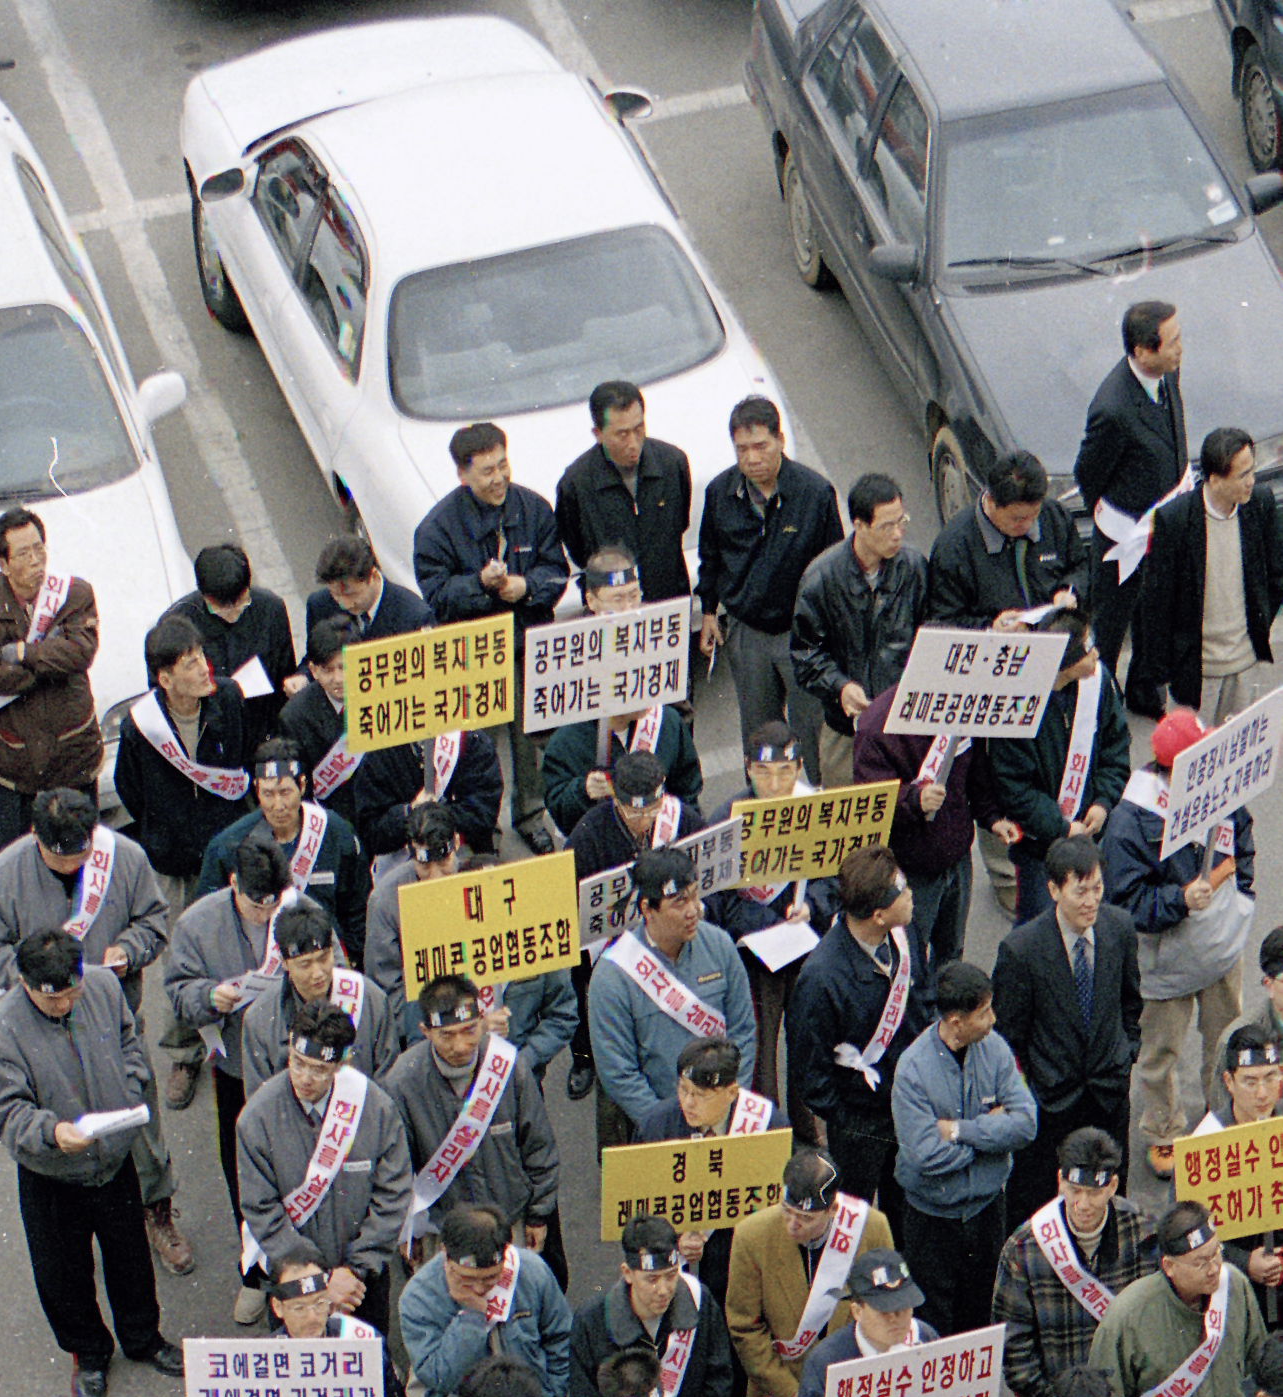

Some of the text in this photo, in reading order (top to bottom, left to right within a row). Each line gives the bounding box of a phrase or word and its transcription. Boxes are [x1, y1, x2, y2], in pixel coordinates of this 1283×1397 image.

[359, 629, 506, 693] 공무원의 복지부동
[535, 613, 680, 674] 공무원의 복지부동
[360, 678, 506, 739] 죽어가는 국가경제
[534, 659, 679, 719] 죽어가는 국가경제
[899, 692, 1040, 726] 레미콘공업협동조합
[819, 793, 888, 828] 복지부동
[470, 1055, 509, 1121] 회사를
[318, 1101, 358, 1167] 회사를
[430, 1126, 480, 1182] 살리자
[1185, 1140, 1260, 1186] 행정실수
[209, 1352, 363, 1378] 코에걸면 코거리
[922, 1345, 992, 1394] 인정하고
